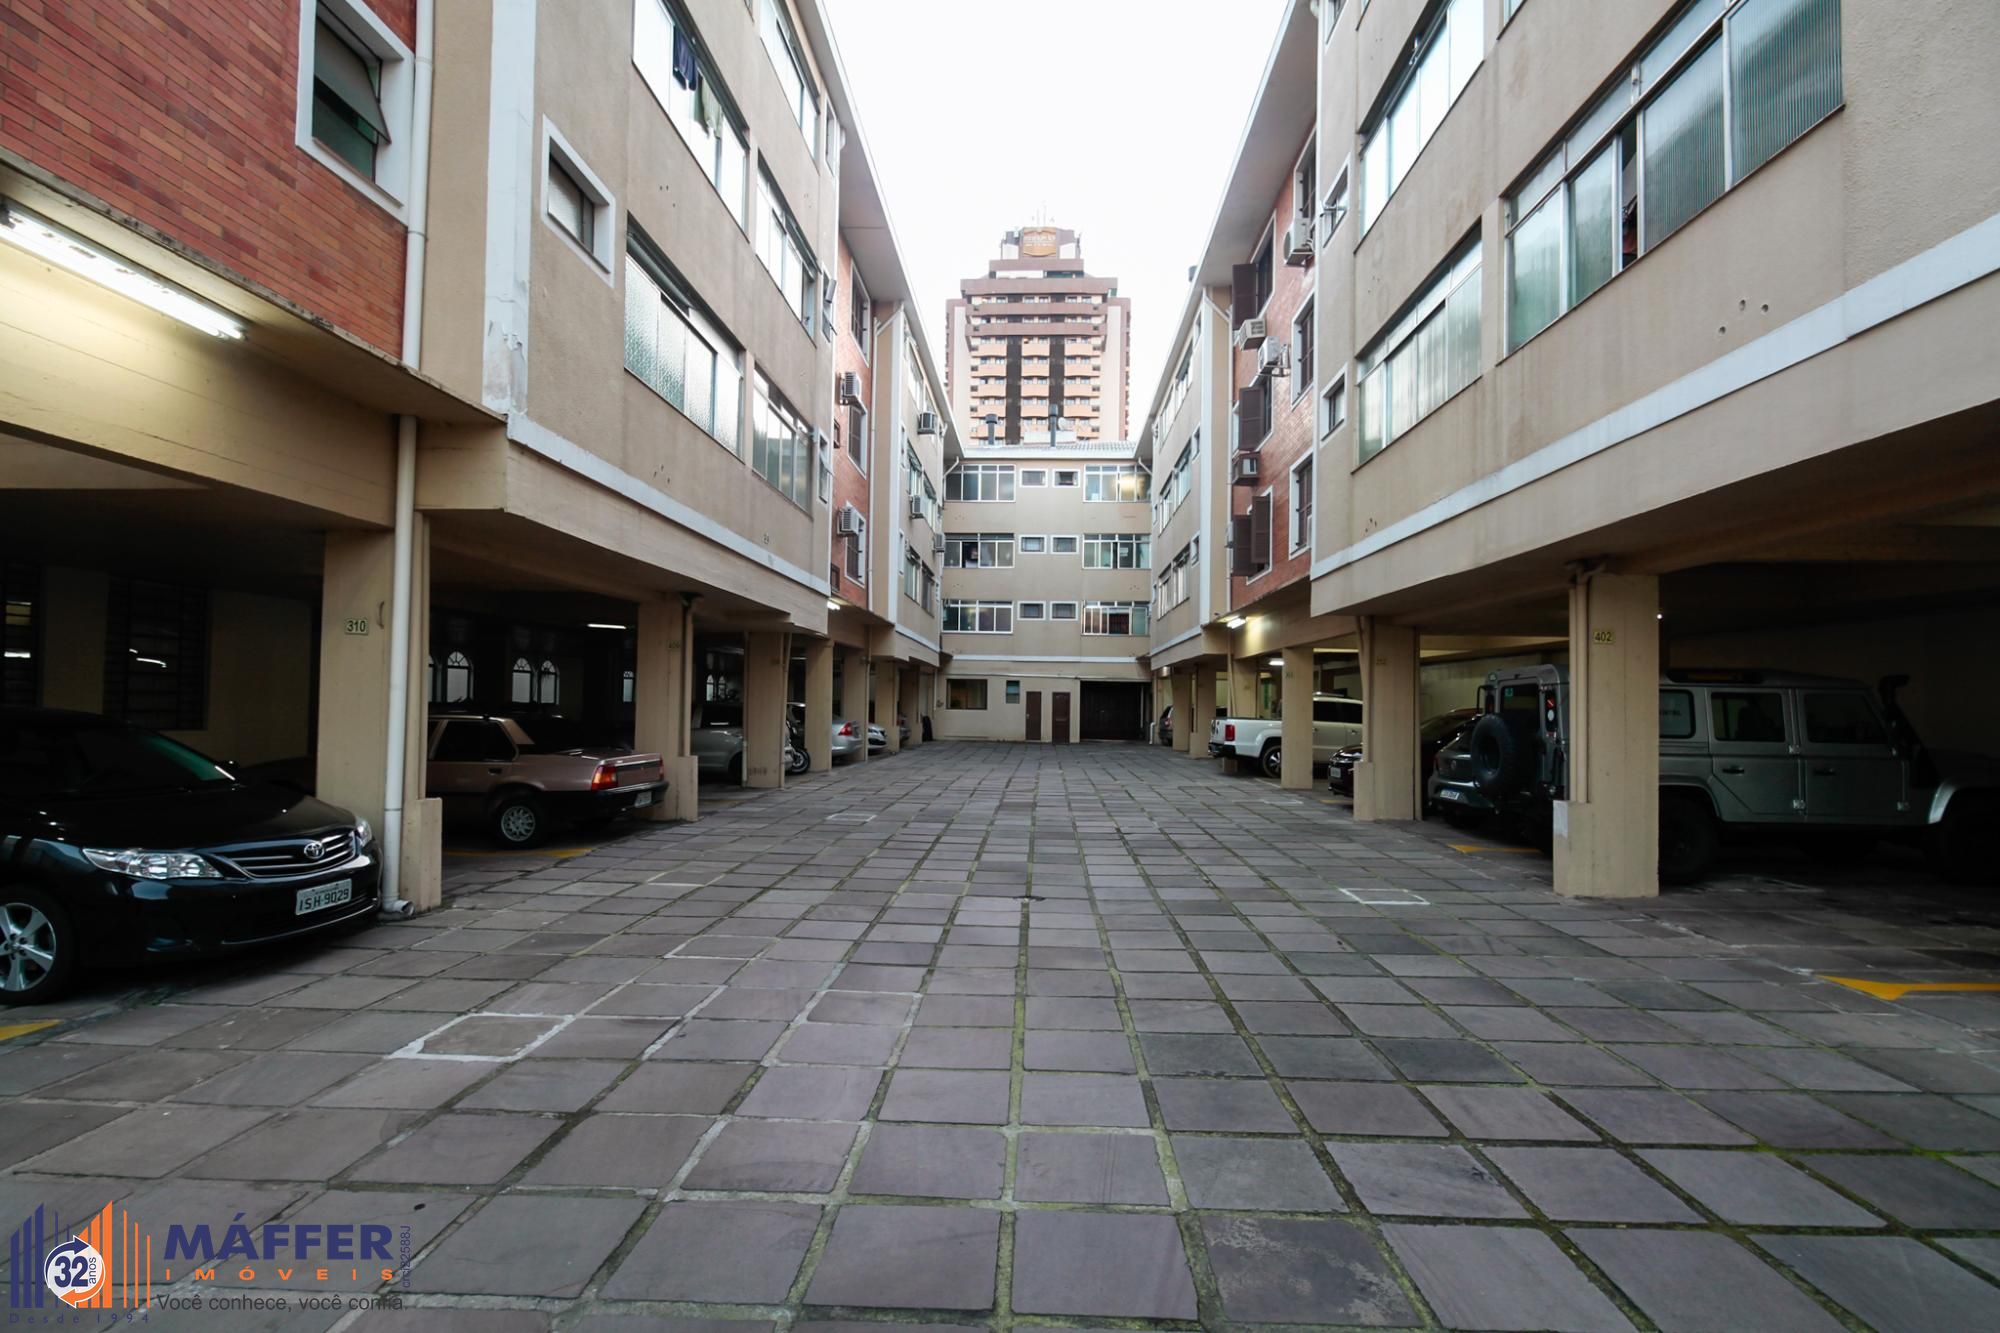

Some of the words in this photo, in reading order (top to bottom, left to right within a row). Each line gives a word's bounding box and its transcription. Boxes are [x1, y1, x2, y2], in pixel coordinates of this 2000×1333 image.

[347, 620, 366, 632] 310
[1594, 631, 1612, 642] 402
[299, 895, 321, 912] ISH
[324, 888, 350, 905] 9029
